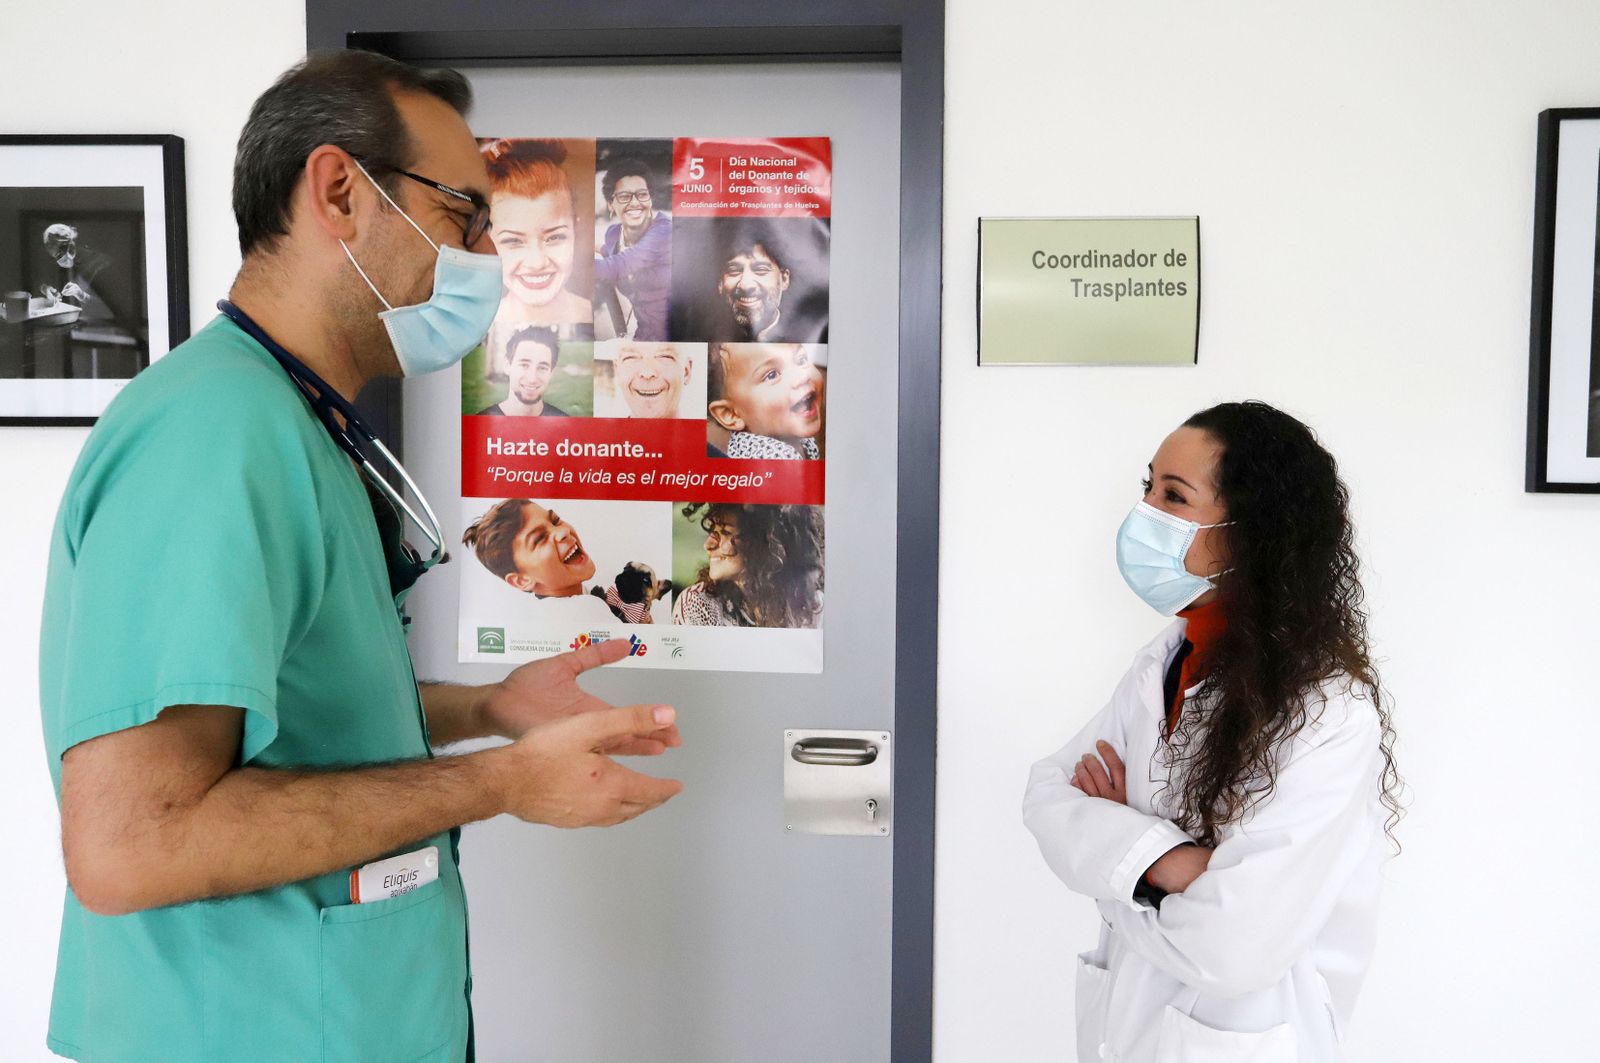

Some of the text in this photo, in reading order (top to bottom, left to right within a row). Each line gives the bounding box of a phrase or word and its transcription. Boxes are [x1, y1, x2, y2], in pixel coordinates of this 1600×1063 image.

[689, 157, 705, 181] 5
[729, 155, 797, 167] Día Nacional
[729, 170, 809, 181] del Donante de
[680, 184, 713, 193] JUNIO
[729, 183, 820, 197] órganos y tejidos
[680, 200, 728, 209] Coordinación
[730, 201, 739, 209] de
[741, 201, 782, 210] Trasplantes
[1032, 248, 1187, 269] Coordinador de
[1070, 277, 1187, 301] Trasplantes
[486, 437, 663, 458] Hazte donante...
[559, 467, 573, 483] la
[578, 468, 612, 484] vida
[617, 473, 636, 484] es
[640, 470, 656, 485] el
[659, 470, 708, 489] mejor
[383, 869, 419, 889] Eliquis
